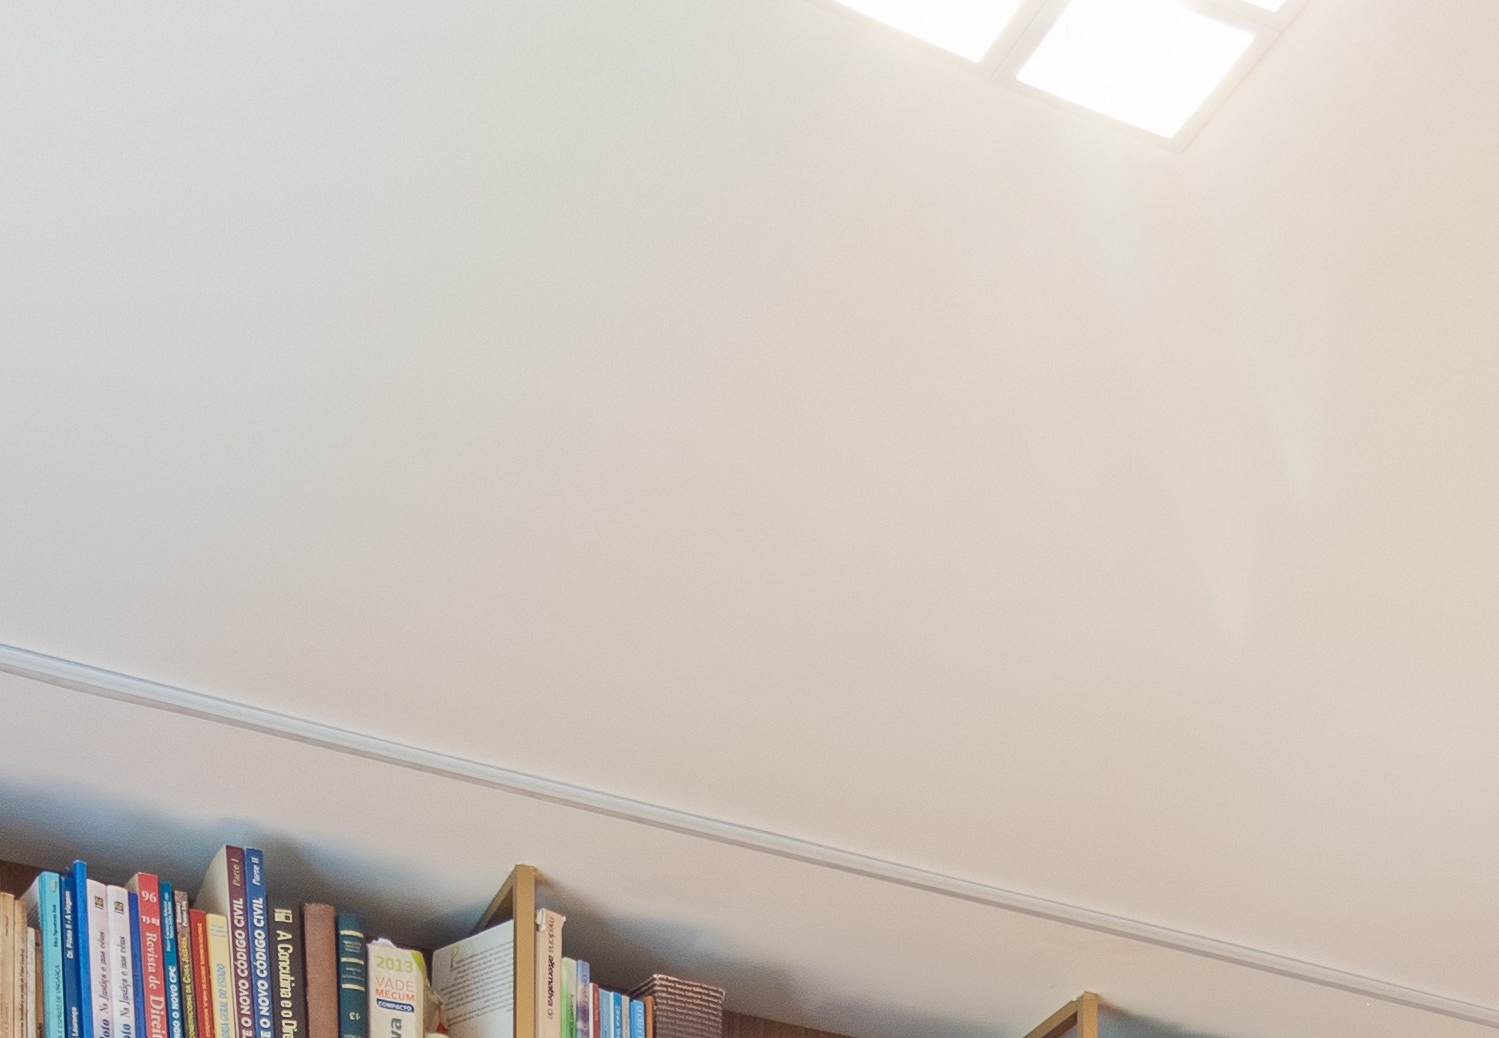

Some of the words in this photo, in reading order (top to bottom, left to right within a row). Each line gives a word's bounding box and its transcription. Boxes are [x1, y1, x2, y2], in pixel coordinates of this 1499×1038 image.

[233, 898, 245, 928] CIVIL
[234, 930, 249, 977] CÓDIGO
[375, 953, 414, 973] 2013
[375, 976, 414, 992] VADE
[238, 979, 252, 1015] NOVO
[375, 988, 415, 1001] MECUM
[241, 1017, 252, 1028] O
